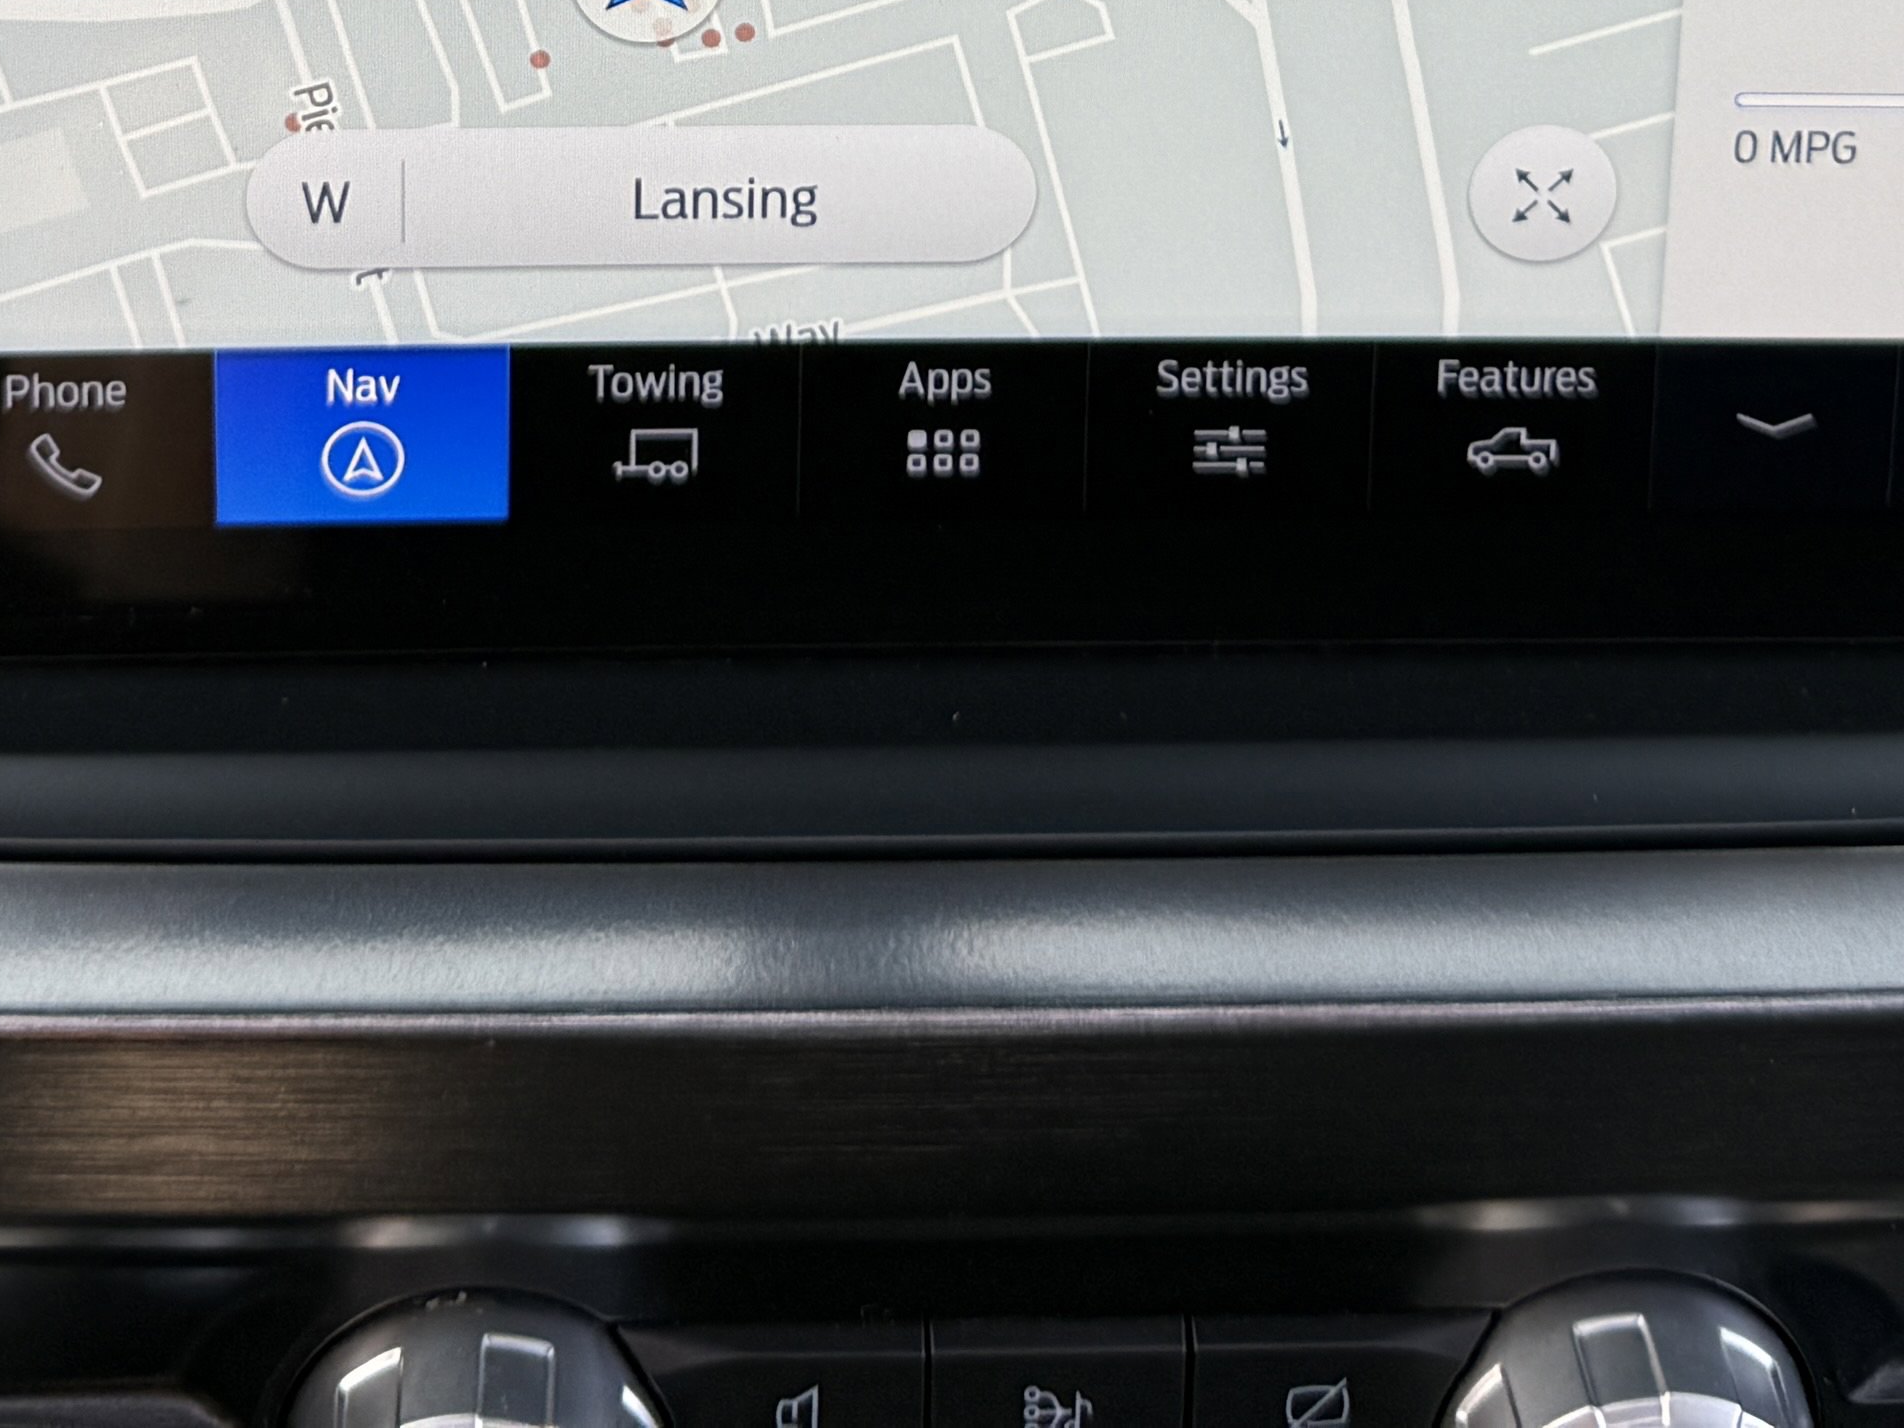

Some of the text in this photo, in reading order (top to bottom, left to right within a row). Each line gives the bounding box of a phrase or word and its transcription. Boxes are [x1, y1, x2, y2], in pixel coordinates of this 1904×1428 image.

[1733, 129, 1859, 165] 0 MPG
[301, 180, 351, 224] W
[633, 176, 819, 228] Lansing
[4, 373, 128, 412] Phone
[325, 367, 401, 407] Nav
[587, 363, 725, 408] Towing
[898, 360, 992, 405] Apps
[1156, 358, 1310, 405] Settings
[1436, 358, 1599, 400] Features
